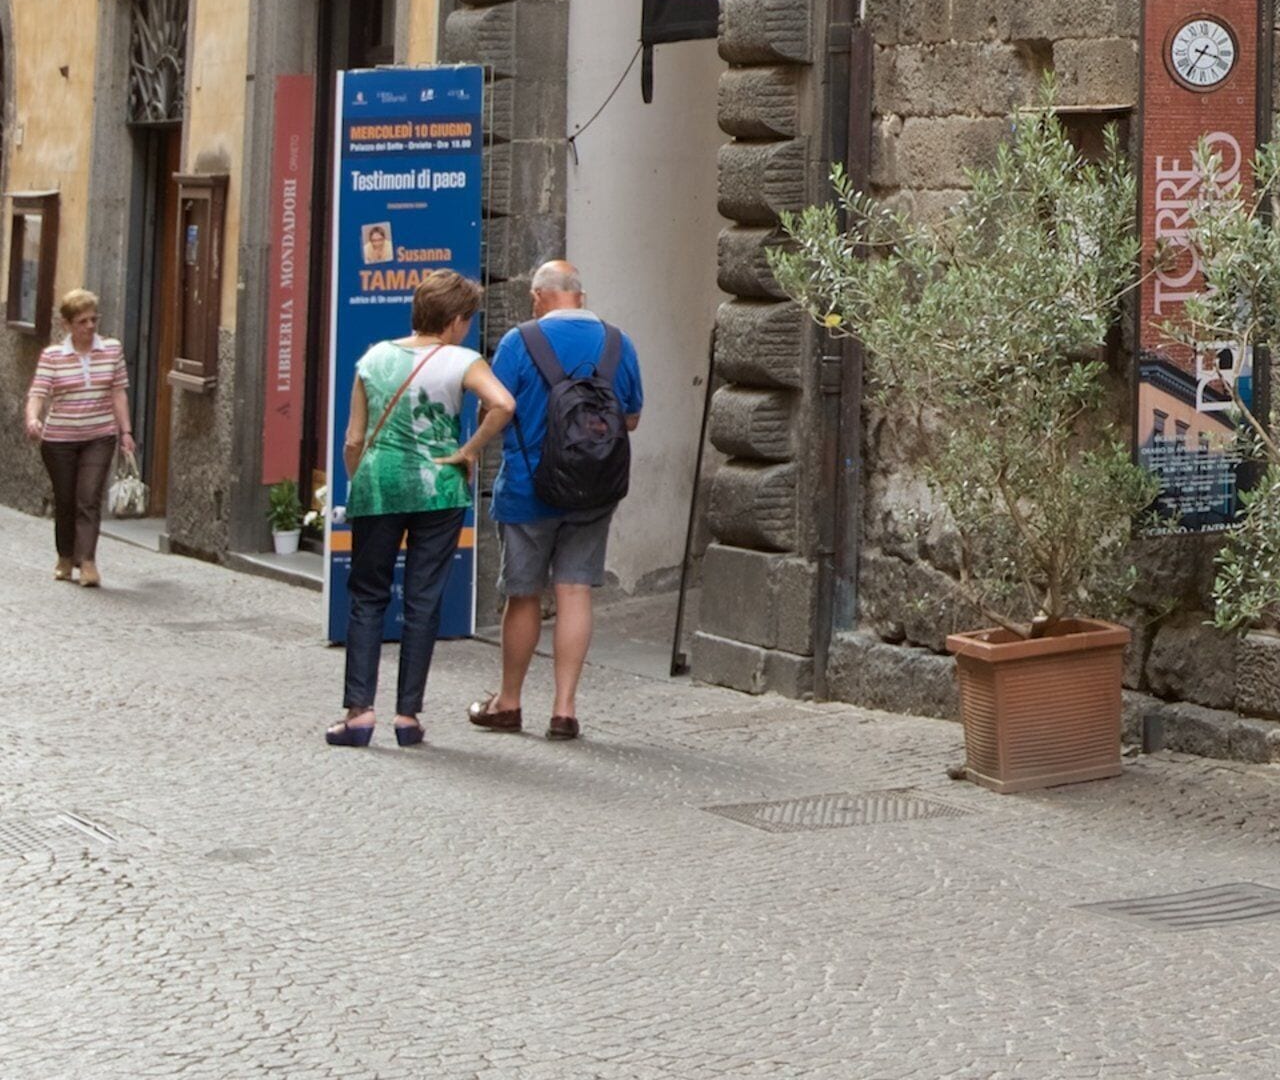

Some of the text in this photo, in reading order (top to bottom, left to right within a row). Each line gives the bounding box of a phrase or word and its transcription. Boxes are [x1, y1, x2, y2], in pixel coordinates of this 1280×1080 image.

[350, 121, 472, 140] MERCOLEDÌ 10 GIUGNO
[351, 169, 467, 192] Testimoni di pace
[280, 178, 298, 289] MONDADORI
[397, 246, 452, 263] Susanna
[1154, 156, 1203, 315] TORRE
[277, 299, 295, 392] LIBRERIA
